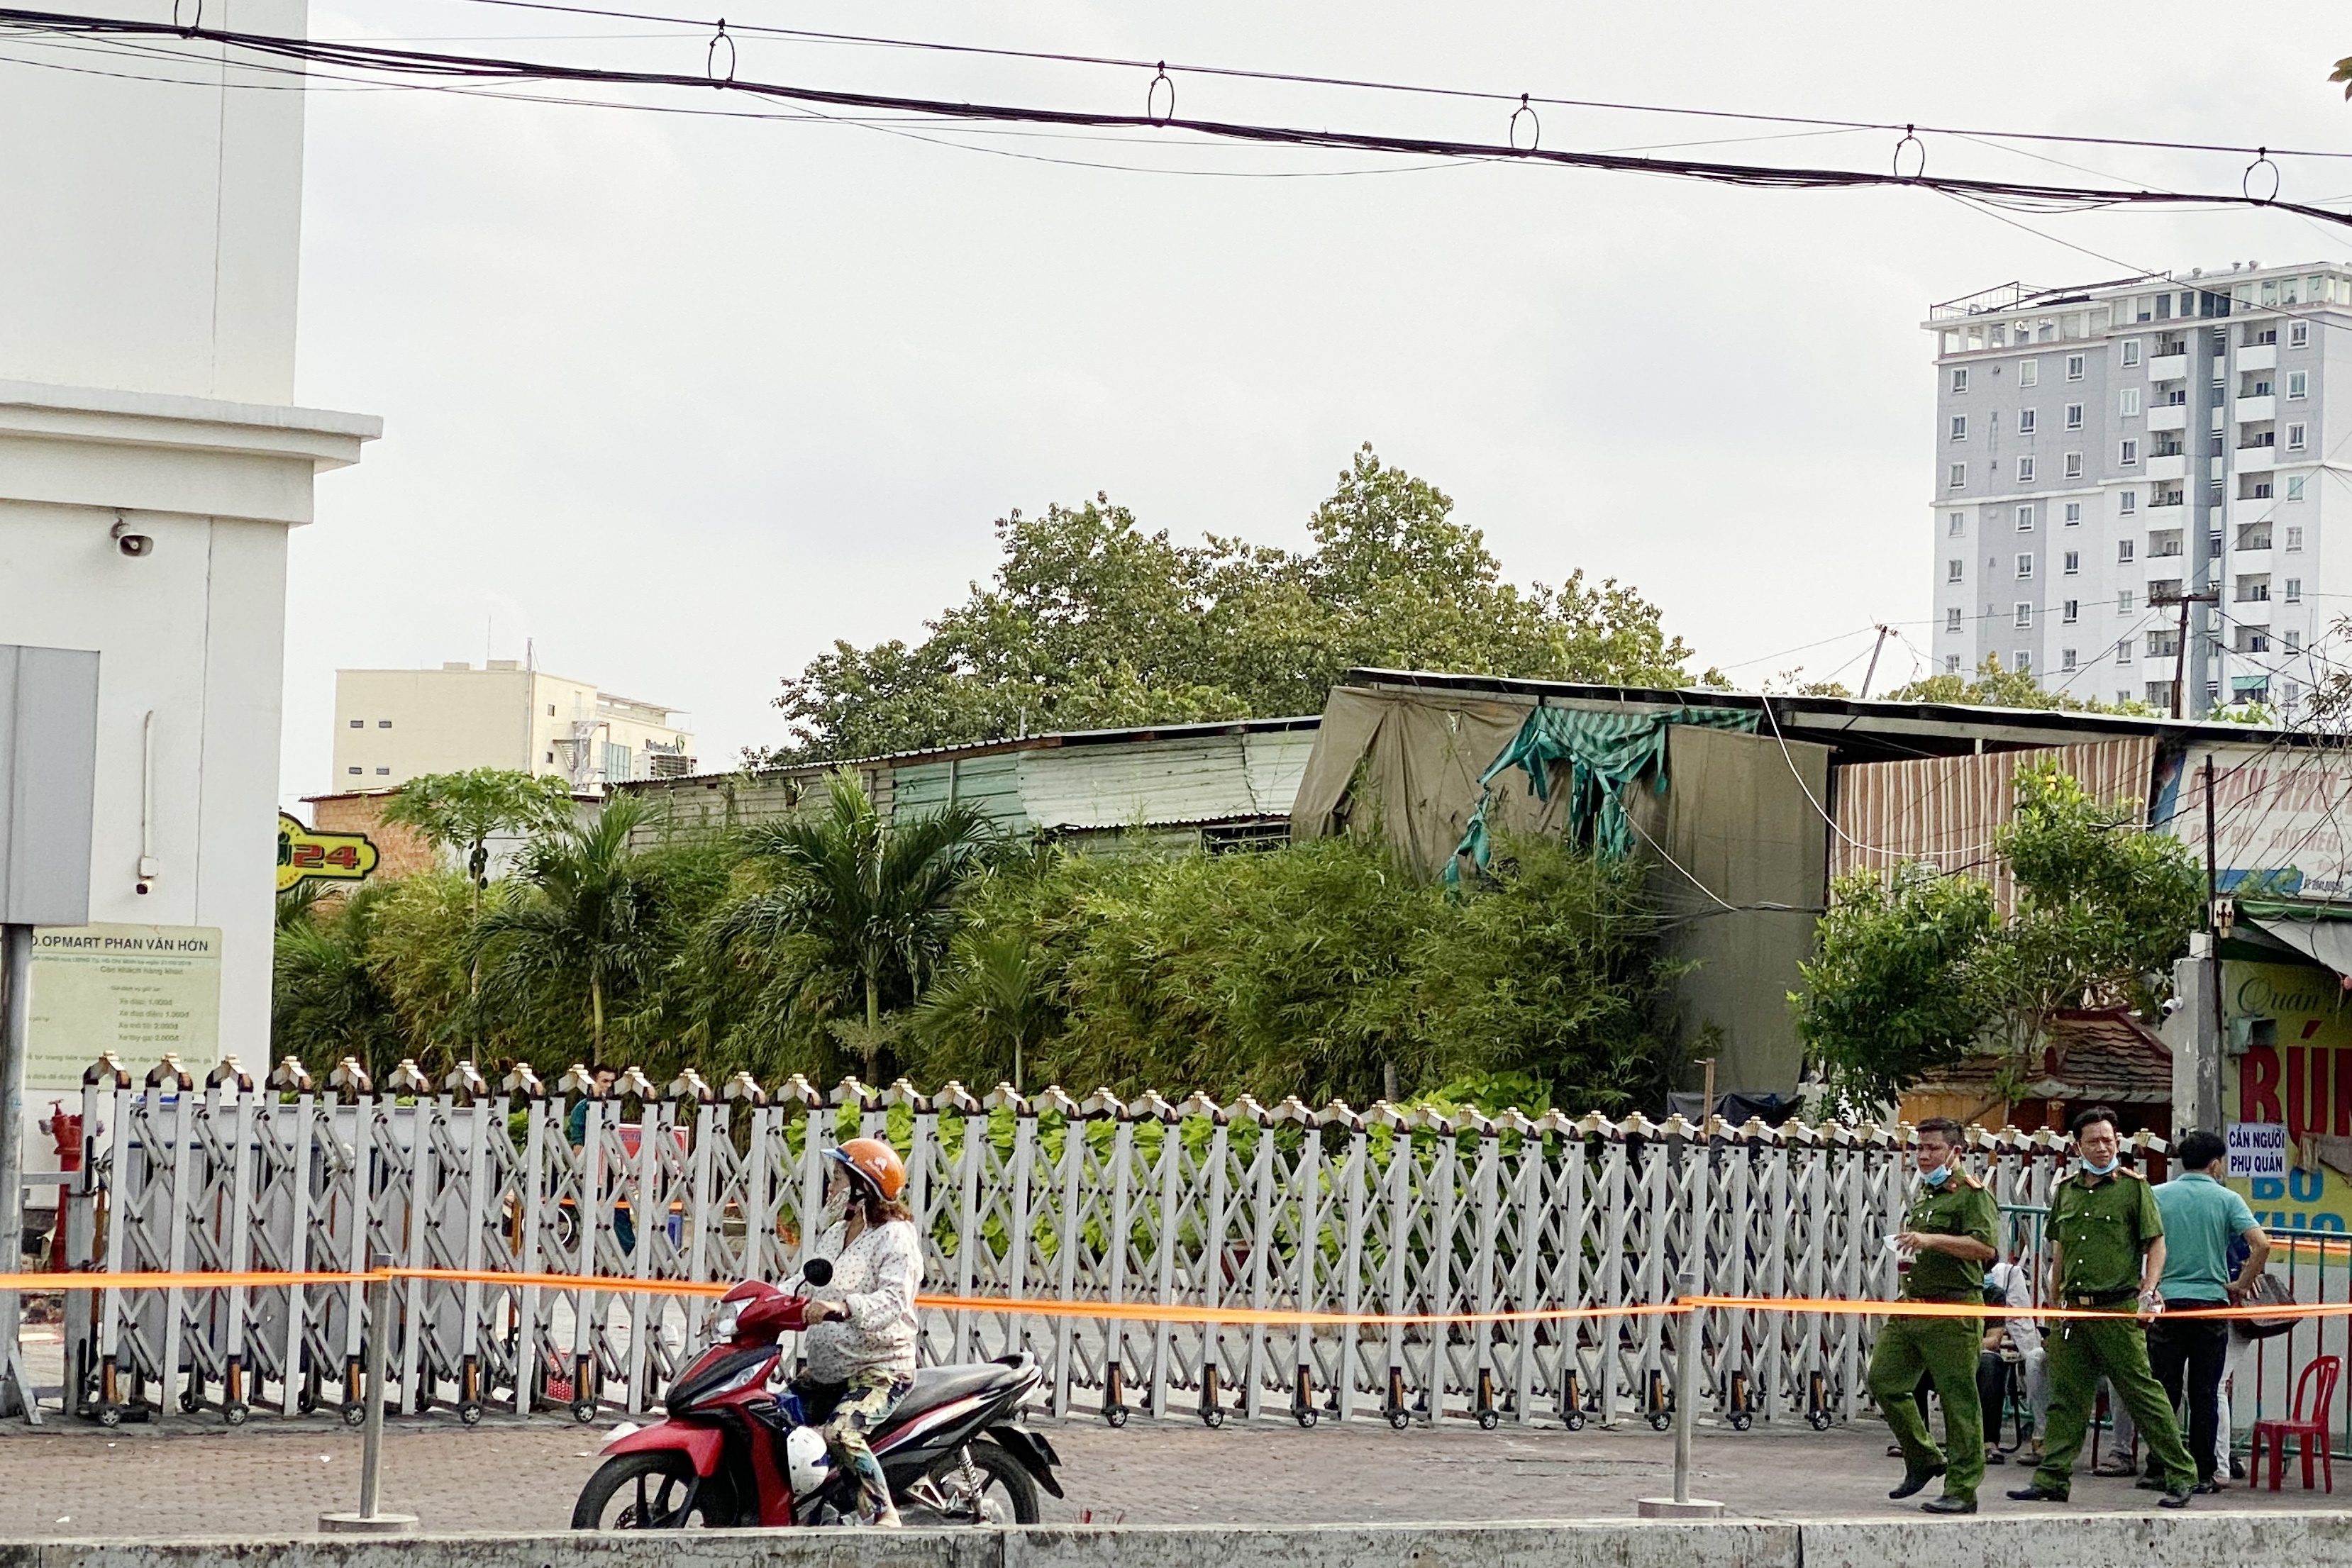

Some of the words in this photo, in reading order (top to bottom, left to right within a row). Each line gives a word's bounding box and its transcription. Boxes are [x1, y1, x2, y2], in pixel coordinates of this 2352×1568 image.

[292, 843, 360, 869] 24
[105, 938, 143, 949] PHAN
[146, 937, 174, 950] VĂN
[178, 938, 208, 951] HỚN
[2237, 977, 2320, 1018] Quán
[2231, 1155, 2251, 1177] PHỤ
[2254, 1151, 2283, 1173] QUÁN
